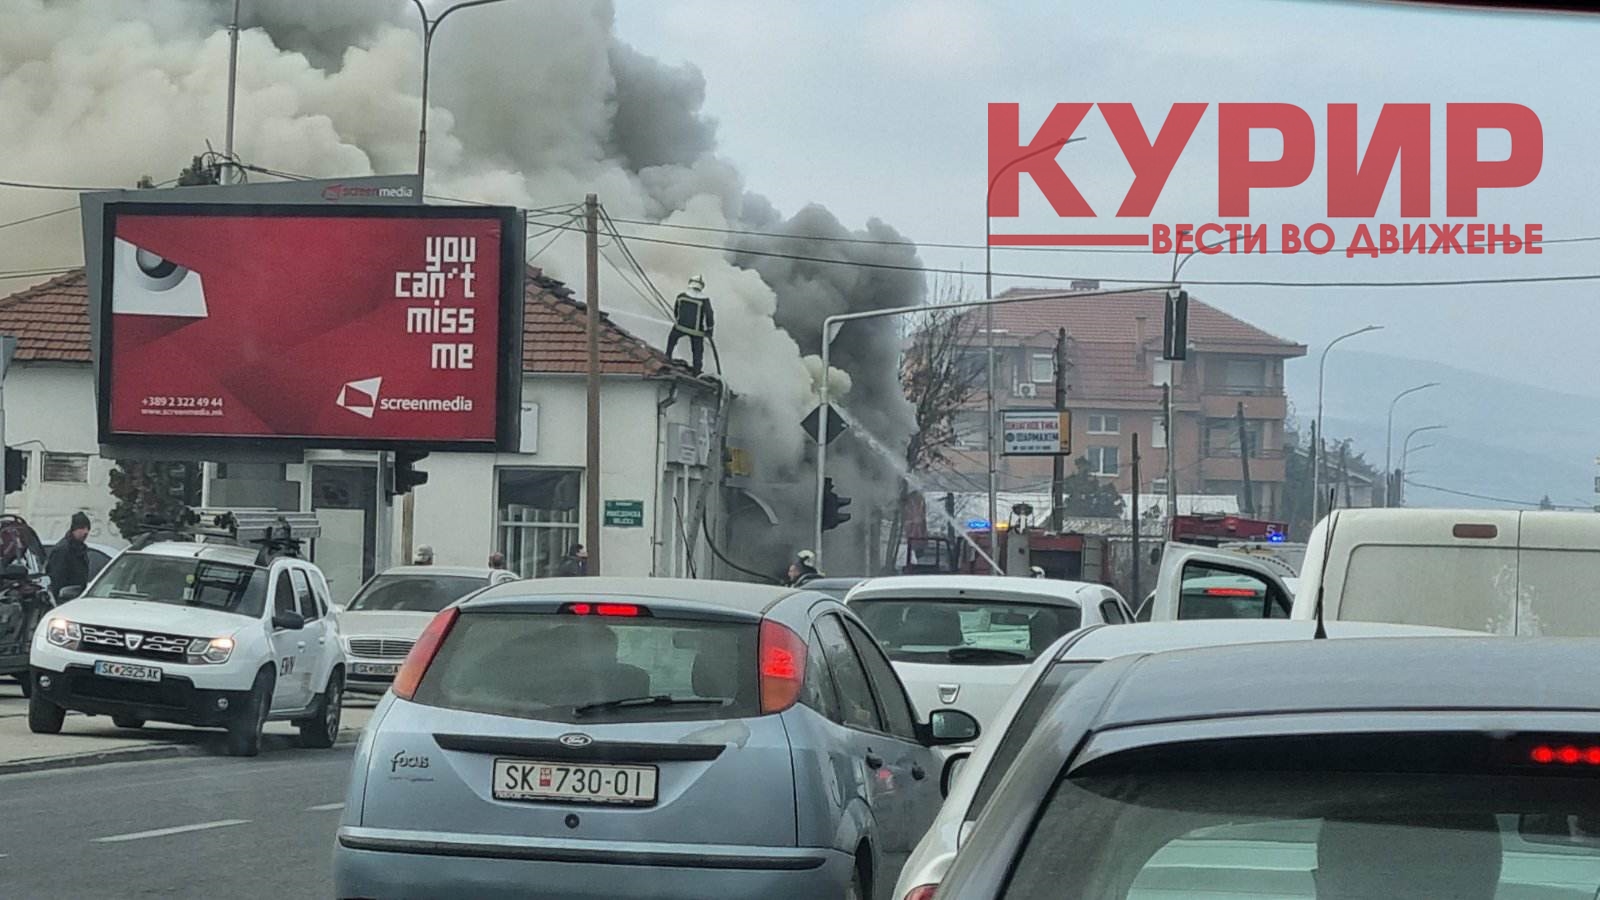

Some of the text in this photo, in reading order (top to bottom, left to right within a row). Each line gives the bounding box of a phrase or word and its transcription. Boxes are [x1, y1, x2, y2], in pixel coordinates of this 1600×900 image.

[426, 236, 476, 272] you
[395, 263, 475, 298] can't
[407, 300, 475, 334] miss
[431, 343, 474, 369] me
[142, 397, 223, 407] +389 2 322 49 44
[380, 396, 473, 412] screenmedia
[505, 765, 534, 791] SK
[555, 767, 641, 797] 730-01
